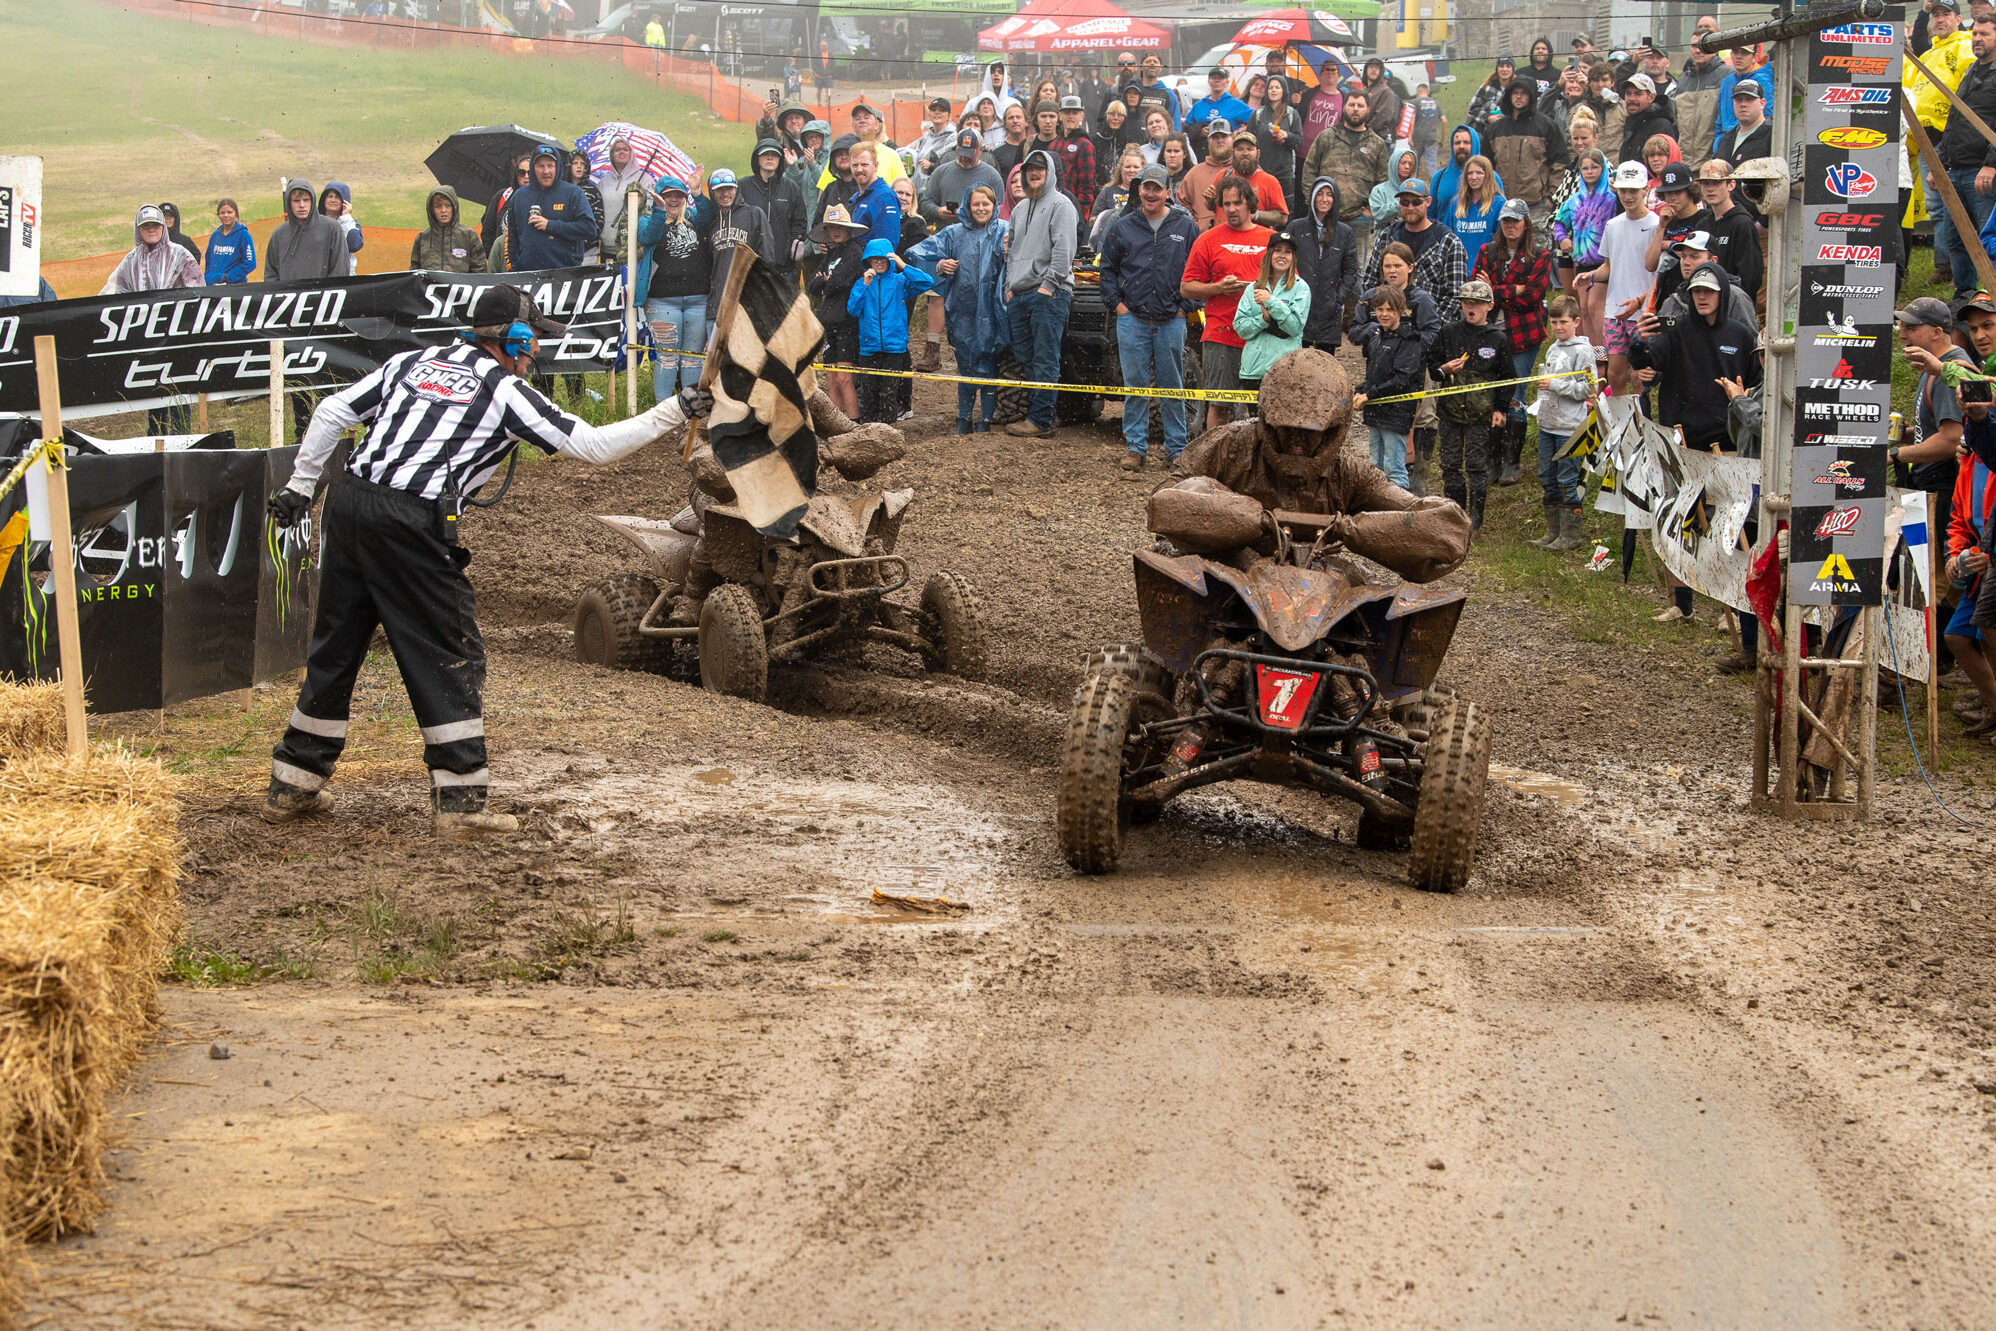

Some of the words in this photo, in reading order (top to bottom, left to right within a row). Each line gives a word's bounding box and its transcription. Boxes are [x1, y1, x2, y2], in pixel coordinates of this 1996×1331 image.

[1821, 34, 1893, 44] UNLIMITED
[1820, 55, 1893, 68] MOOSE
[1846, 67, 1885, 76] RACING
[1820, 87, 1891, 104] AMSOIL
[1323, 100, 1335, 110] be
[1820, 130, 1887, 144] FMF
[1826, 163, 1862, 197] VP
[553, 203, 565, 211] CAT
[1461, 220, 1487, 230] YAMAHA
[1815, 212, 1884, 226] GBC
[1818, 245, 1881, 260] KENDA
[1856, 260, 1879, 268] TIRES
[1824, 285, 1884, 294] DUNLOP
[93, 288, 347, 344] SPECIALIZED
[1813, 338, 1876, 347] MICHELIN
[124, 346, 328, 389] turbo
[407, 364, 479, 395] GNCC
[1809, 378, 1877, 390] TUSK
[417, 381, 454, 398] RACING
[1804, 402, 1880, 416] METHOD
[1823, 434, 1878, 444] WISECO
[80, 583, 155, 602] NERGY
[1809, 581, 1862, 593] ARMA
